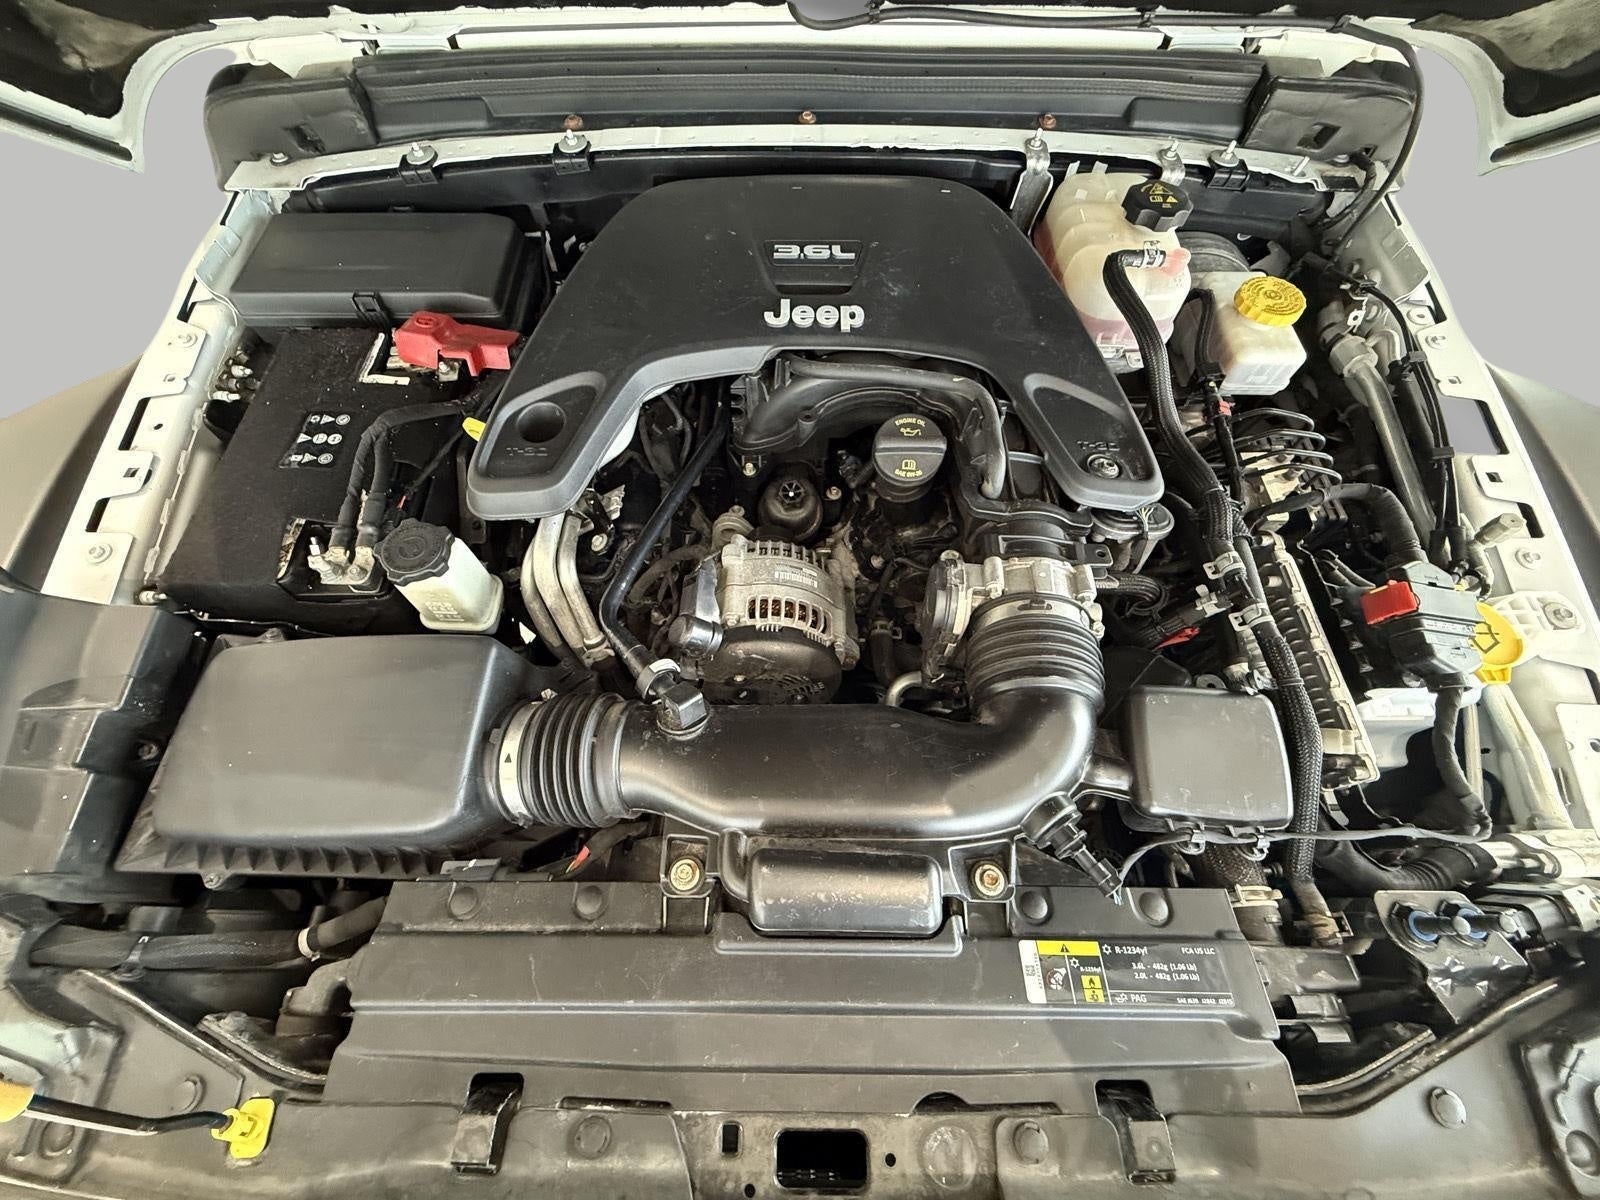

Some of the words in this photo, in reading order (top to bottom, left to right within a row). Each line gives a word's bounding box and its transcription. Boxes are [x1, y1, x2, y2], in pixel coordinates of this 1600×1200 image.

[773, 244, 856, 260] 3.6L
[763, 298, 865, 333] Jeep
[894, 417, 917, 426] ENGINE
[1114, 946, 1148, 956] R-1234yf
[1181, 947, 1194, 955] FCA
[1194, 947, 1204, 955] US
[1204, 947, 1216, 955] LLC
[1131, 962, 1146, 970] 3.6L
[1130, 993, 1147, 1003] PAG
